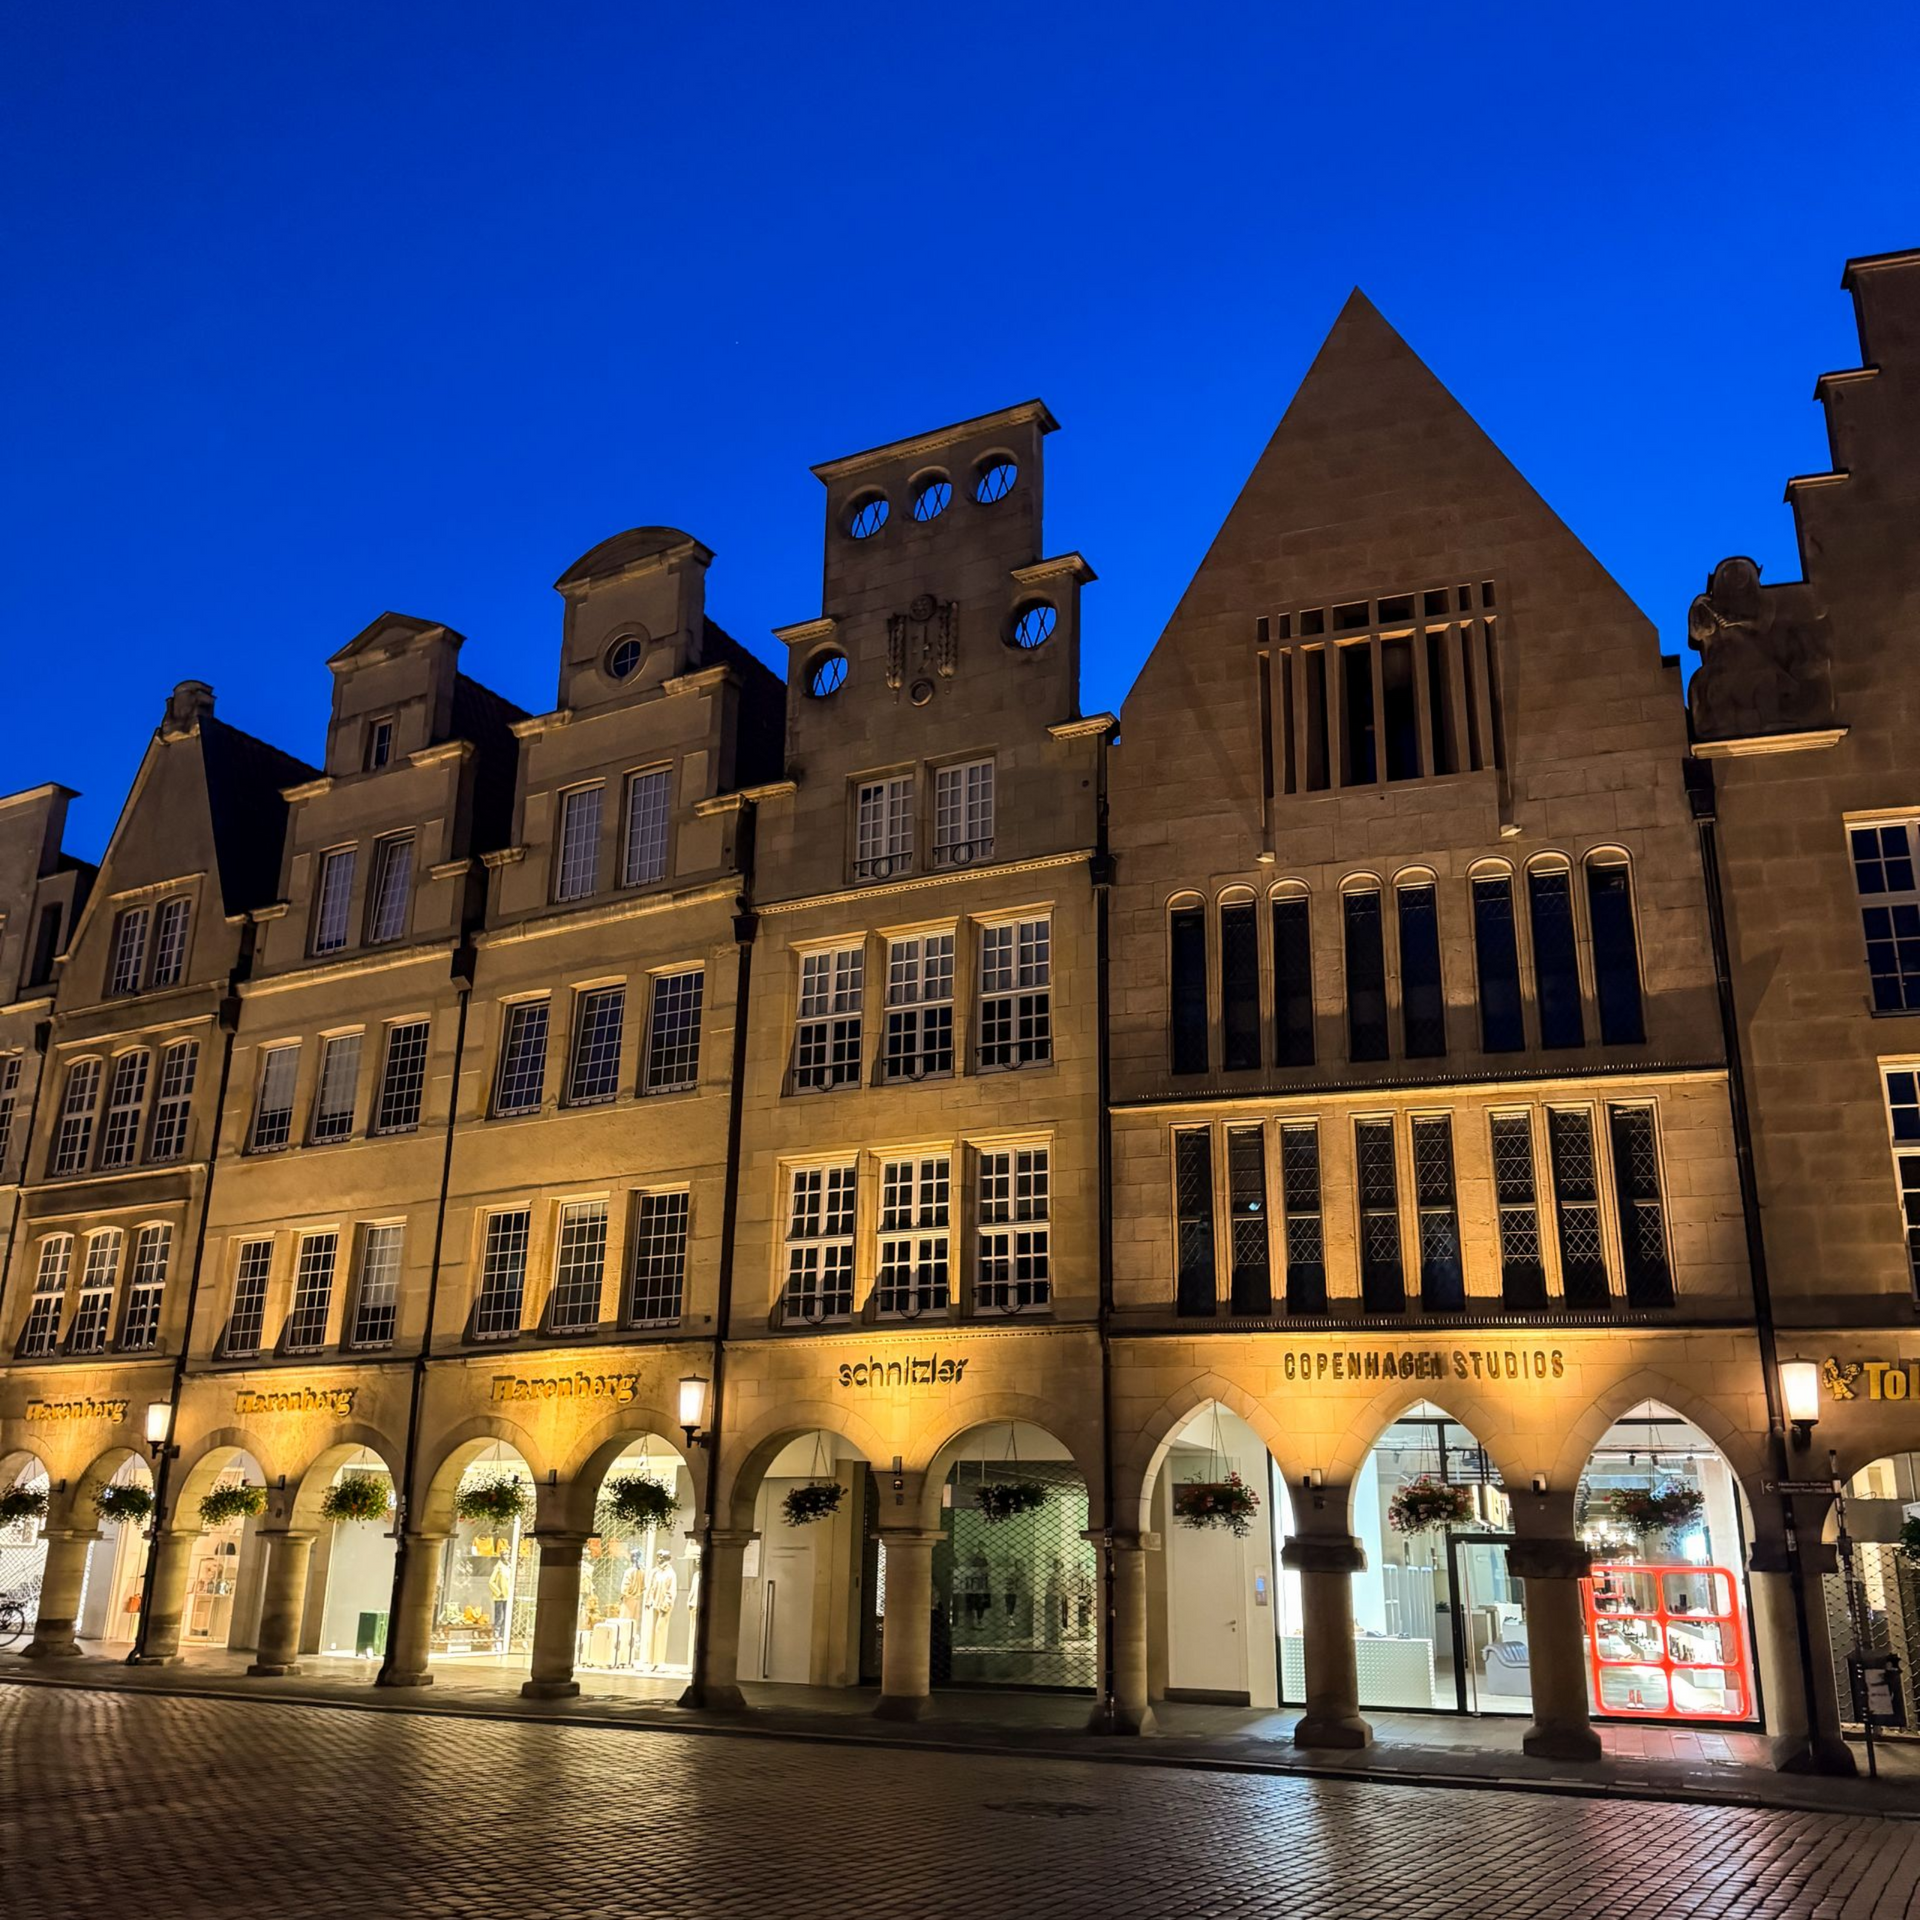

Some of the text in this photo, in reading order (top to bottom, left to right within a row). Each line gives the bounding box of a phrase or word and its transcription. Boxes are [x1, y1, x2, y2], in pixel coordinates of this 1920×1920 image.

[838, 1352, 969, 1387] schnitzler
[1284, 1350, 1564, 1380] COPENHAGEN STUDIOS
[236, 1387, 357, 1416] Harenberg
[490, 1372, 640, 1403] Harenberg
[25, 1398, 128, 1424] Harenberg
